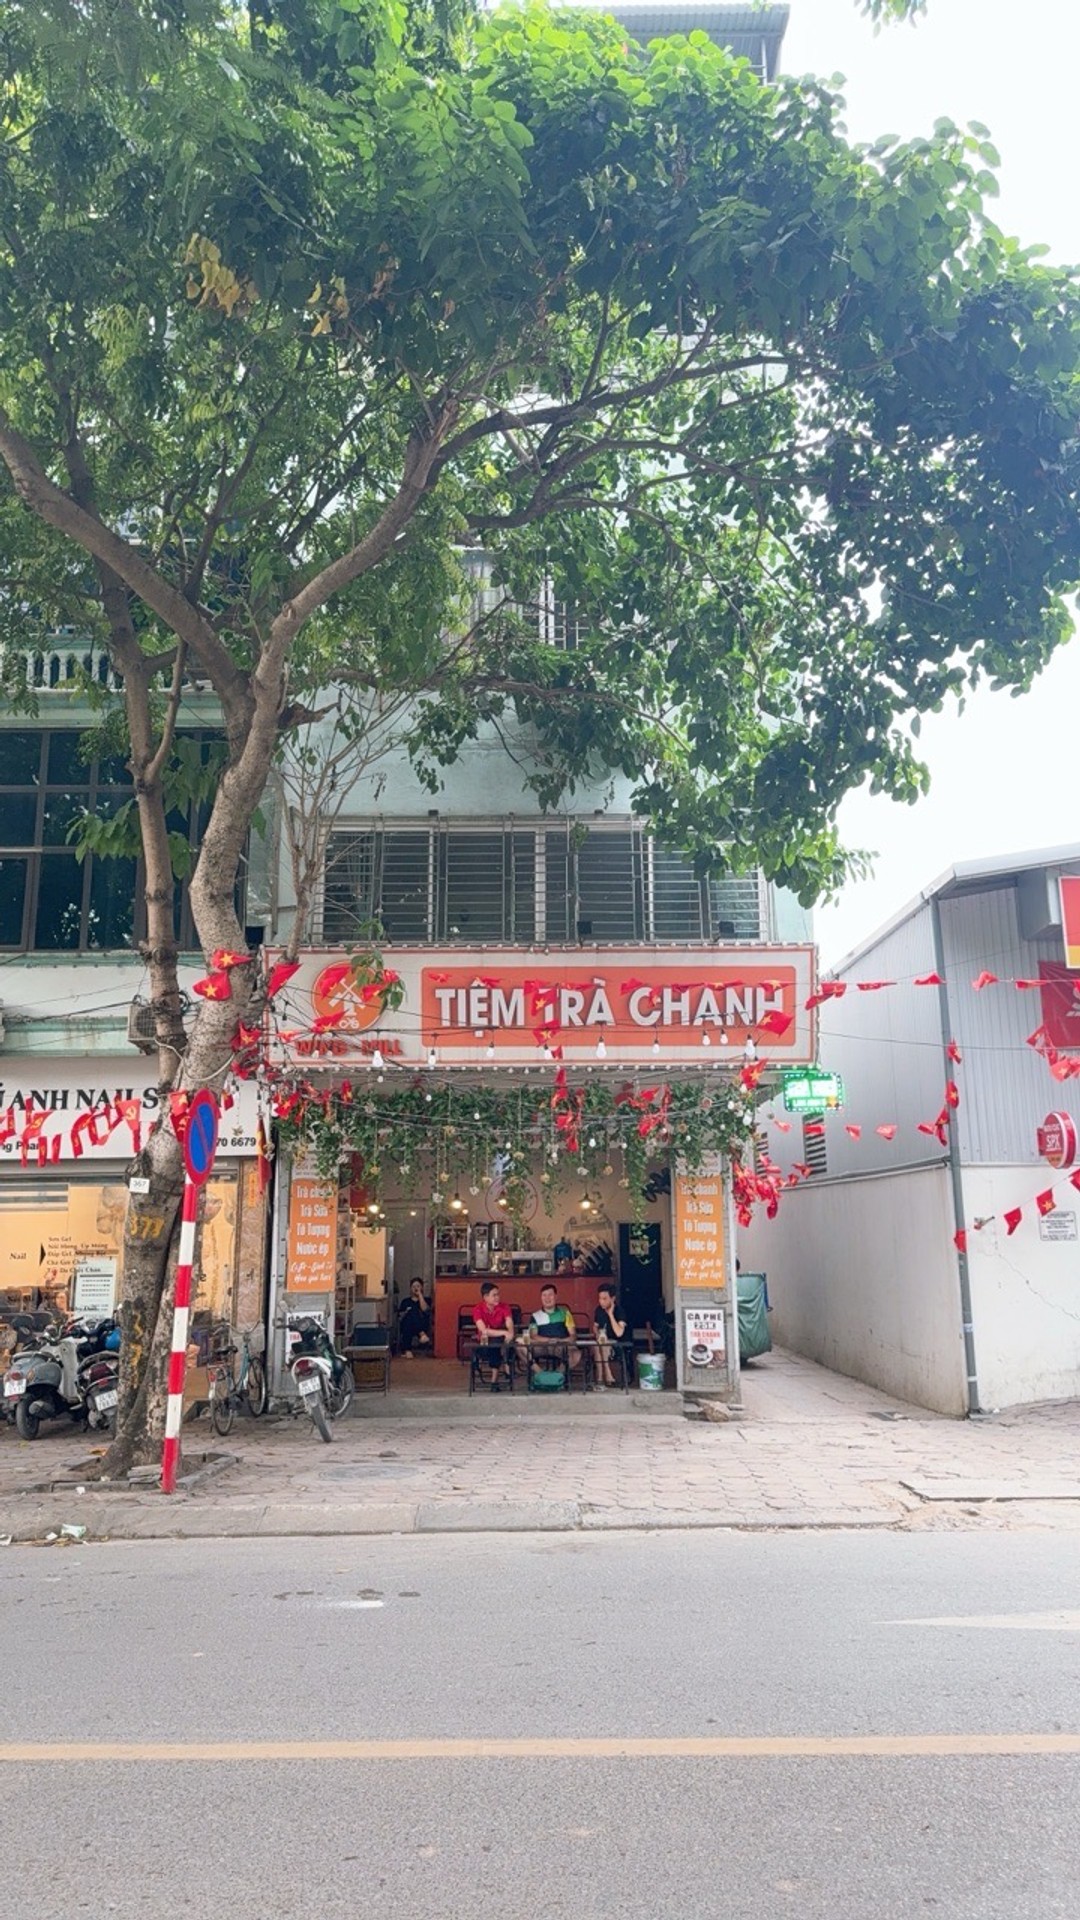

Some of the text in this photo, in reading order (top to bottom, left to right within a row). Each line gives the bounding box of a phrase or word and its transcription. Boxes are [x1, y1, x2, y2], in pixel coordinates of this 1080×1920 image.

[435, 977, 784, 1037] TIỆM TRÀ CHANH
[9, 1089, 70, 1110] ANH
[231, 1137, 256, 1147] 6679
[9, 1252, 27, 1260] Nail
